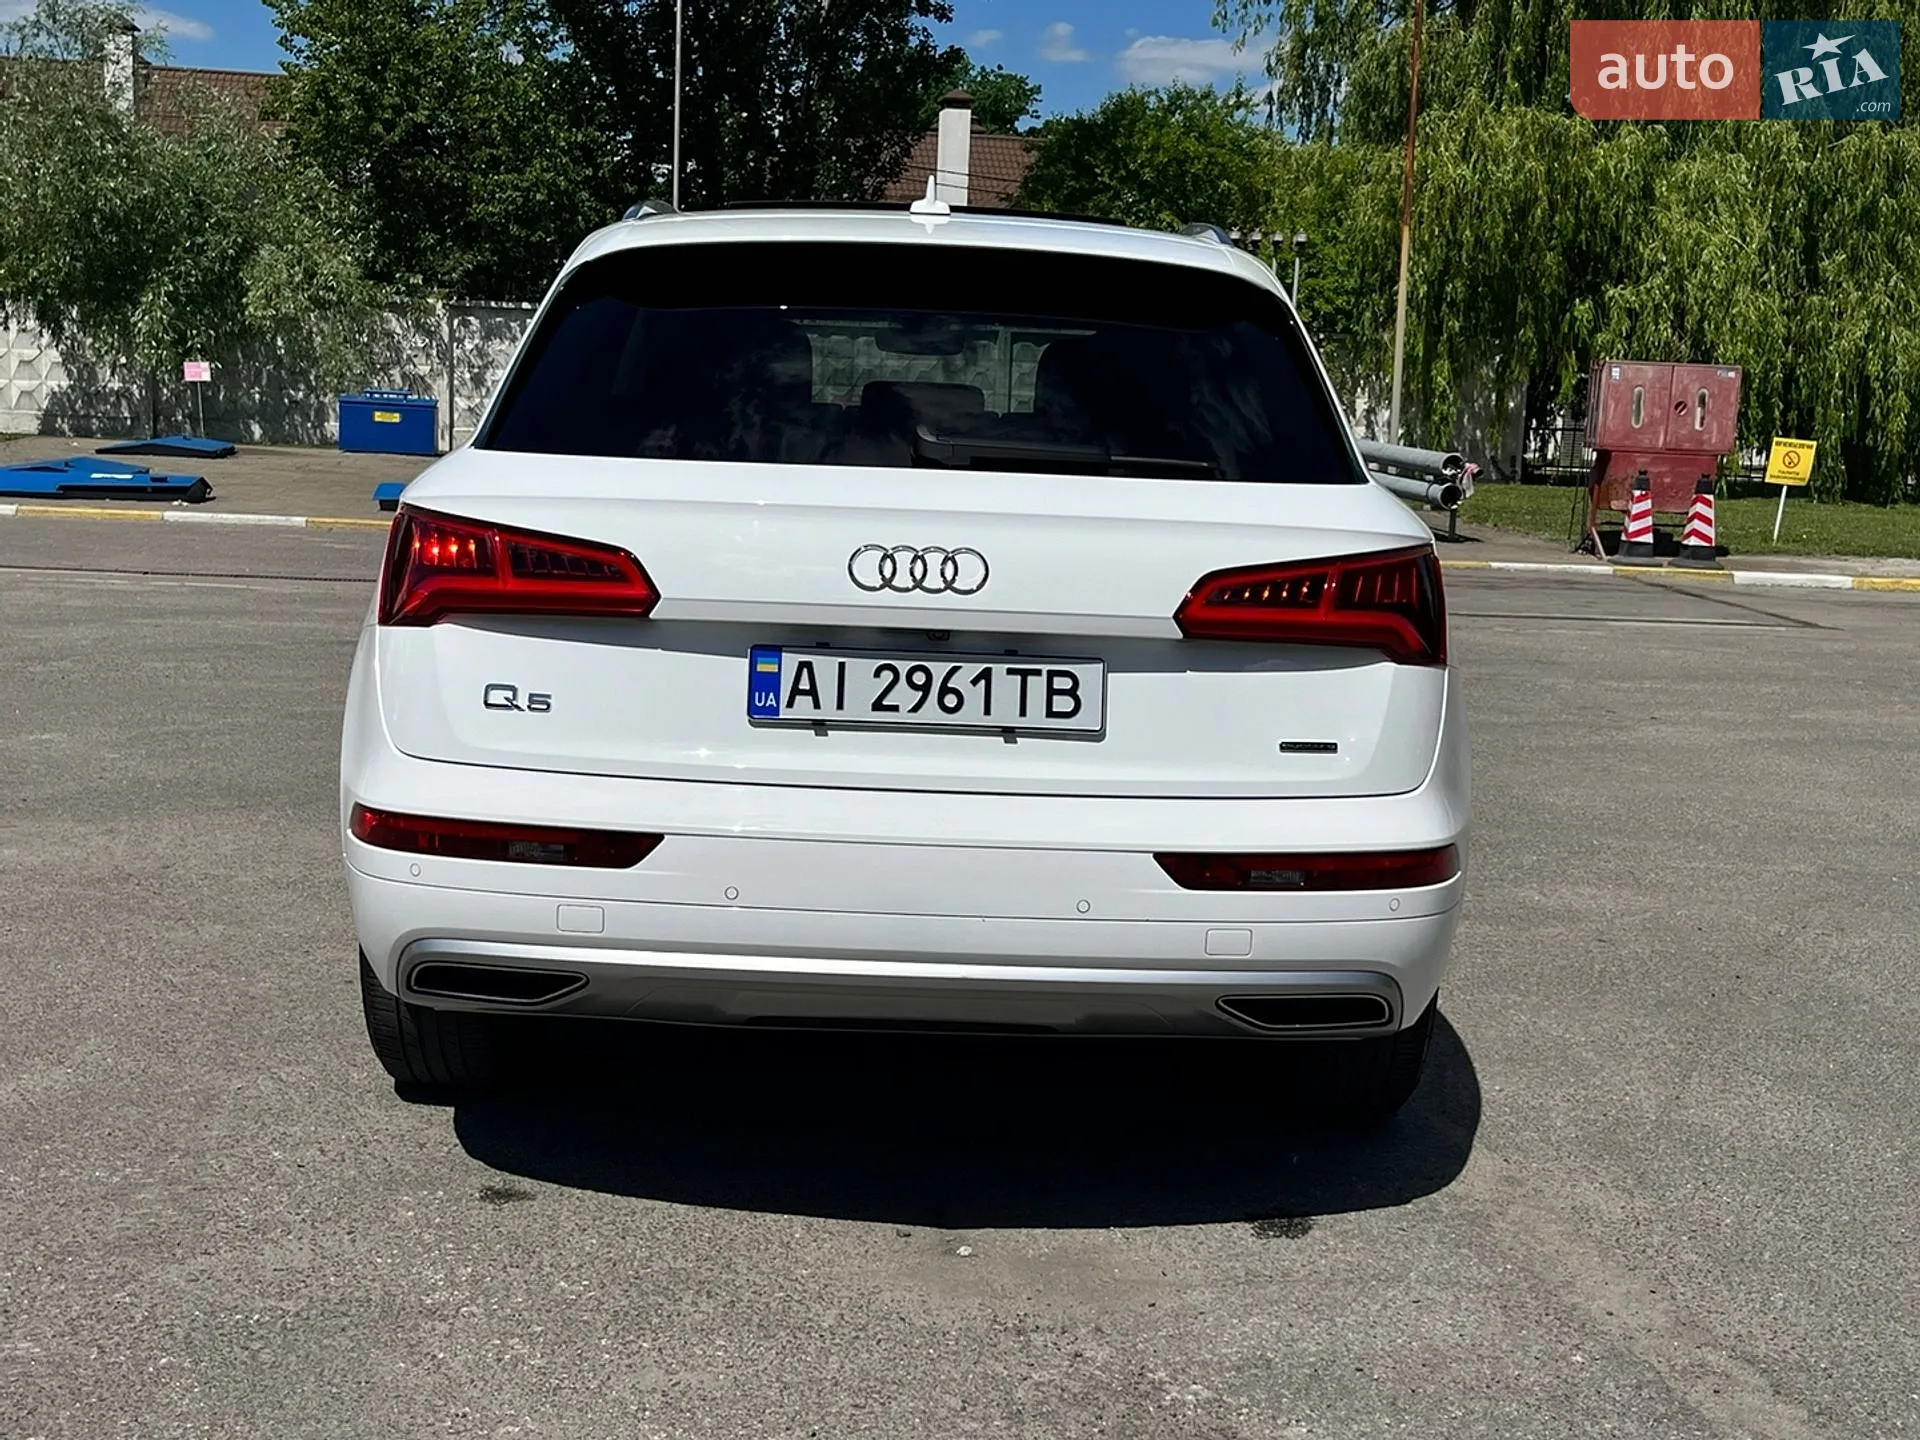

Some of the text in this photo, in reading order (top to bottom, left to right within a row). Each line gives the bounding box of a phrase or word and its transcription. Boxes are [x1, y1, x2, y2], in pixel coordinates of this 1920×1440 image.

[483, 683, 552, 713] Q5
[754, 691, 777, 707] UA
[785, 660, 846, 711] AI
